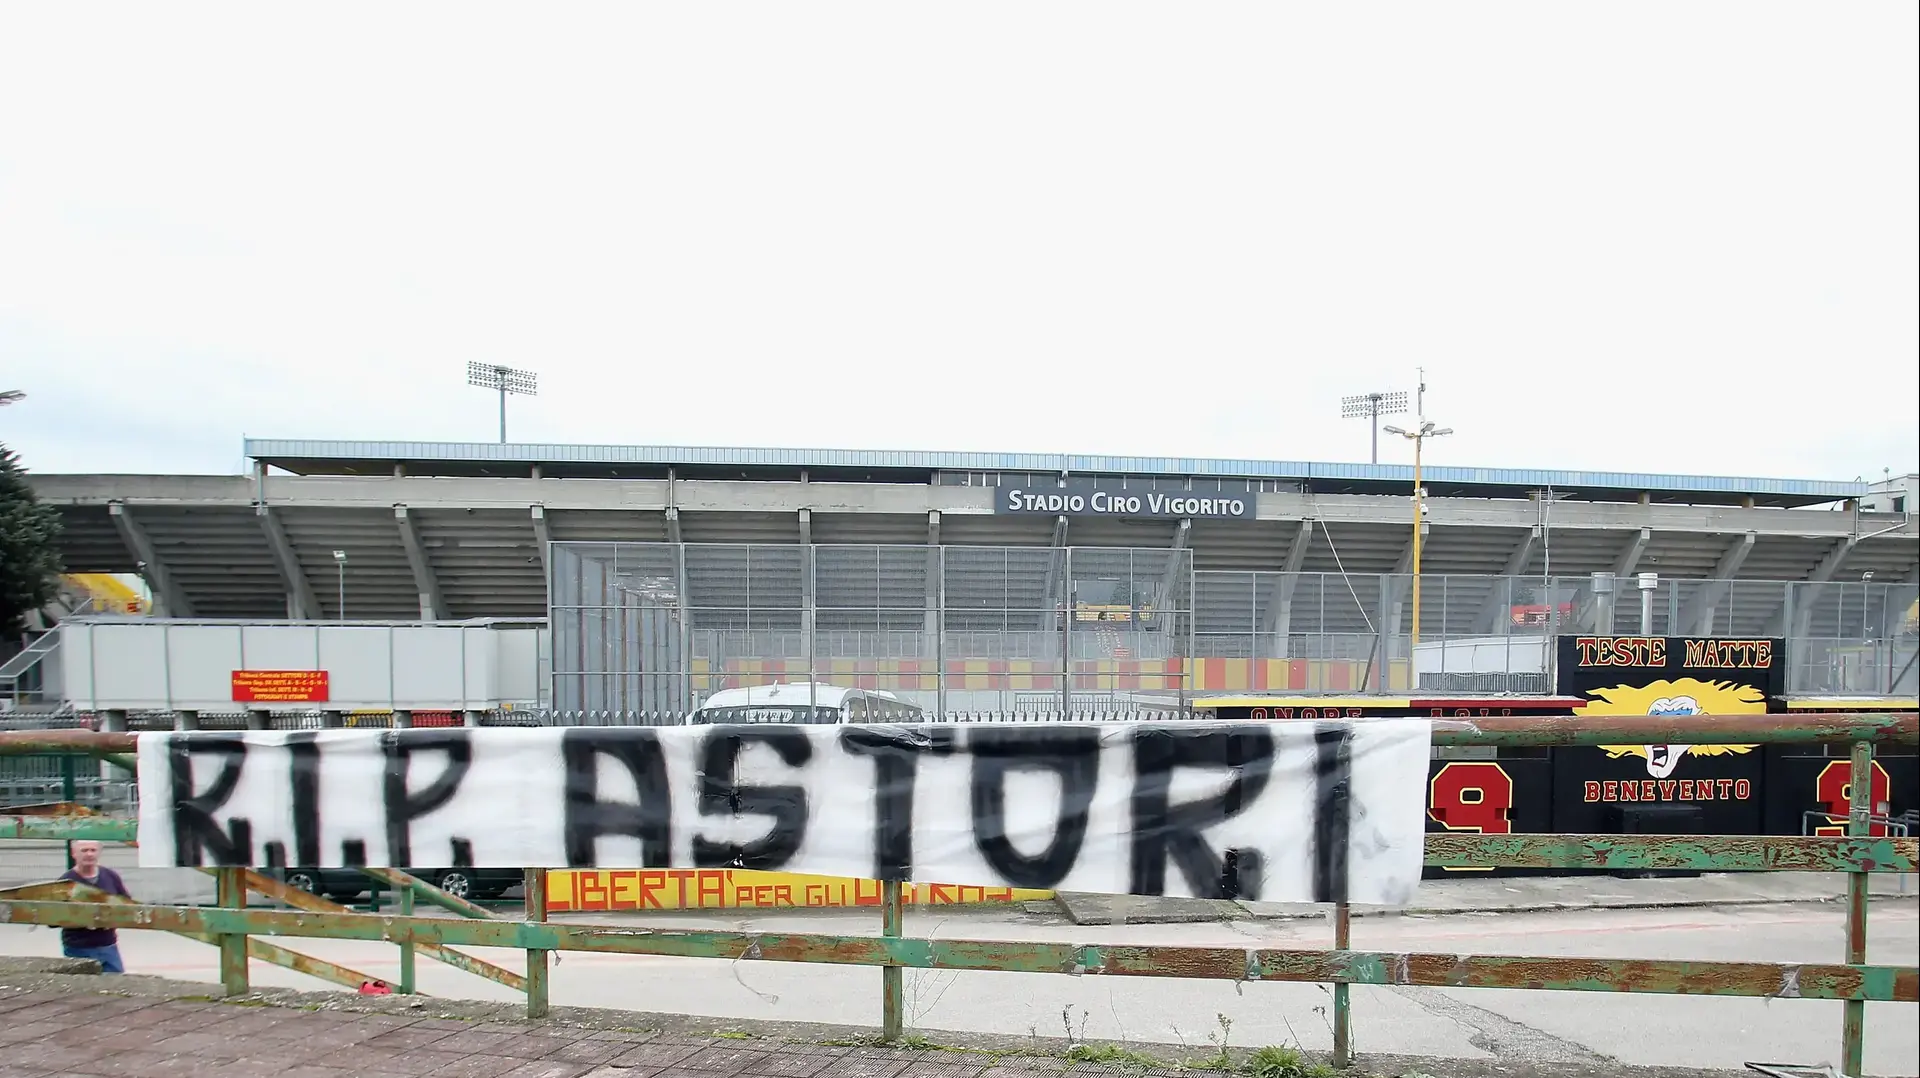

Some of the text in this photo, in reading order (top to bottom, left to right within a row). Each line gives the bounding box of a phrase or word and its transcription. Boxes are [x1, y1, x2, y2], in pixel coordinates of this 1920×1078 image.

[1008, 489, 1245, 516] STADIO CIRO VIGORITO
[1576, 637, 1772, 669] TESTE MATTE
[1583, 778, 1751, 803] BENEVENTO
[562, 724, 1349, 902] ASTORI
[736, 885, 795, 907] PER
[805, 884, 846, 907] GLI
